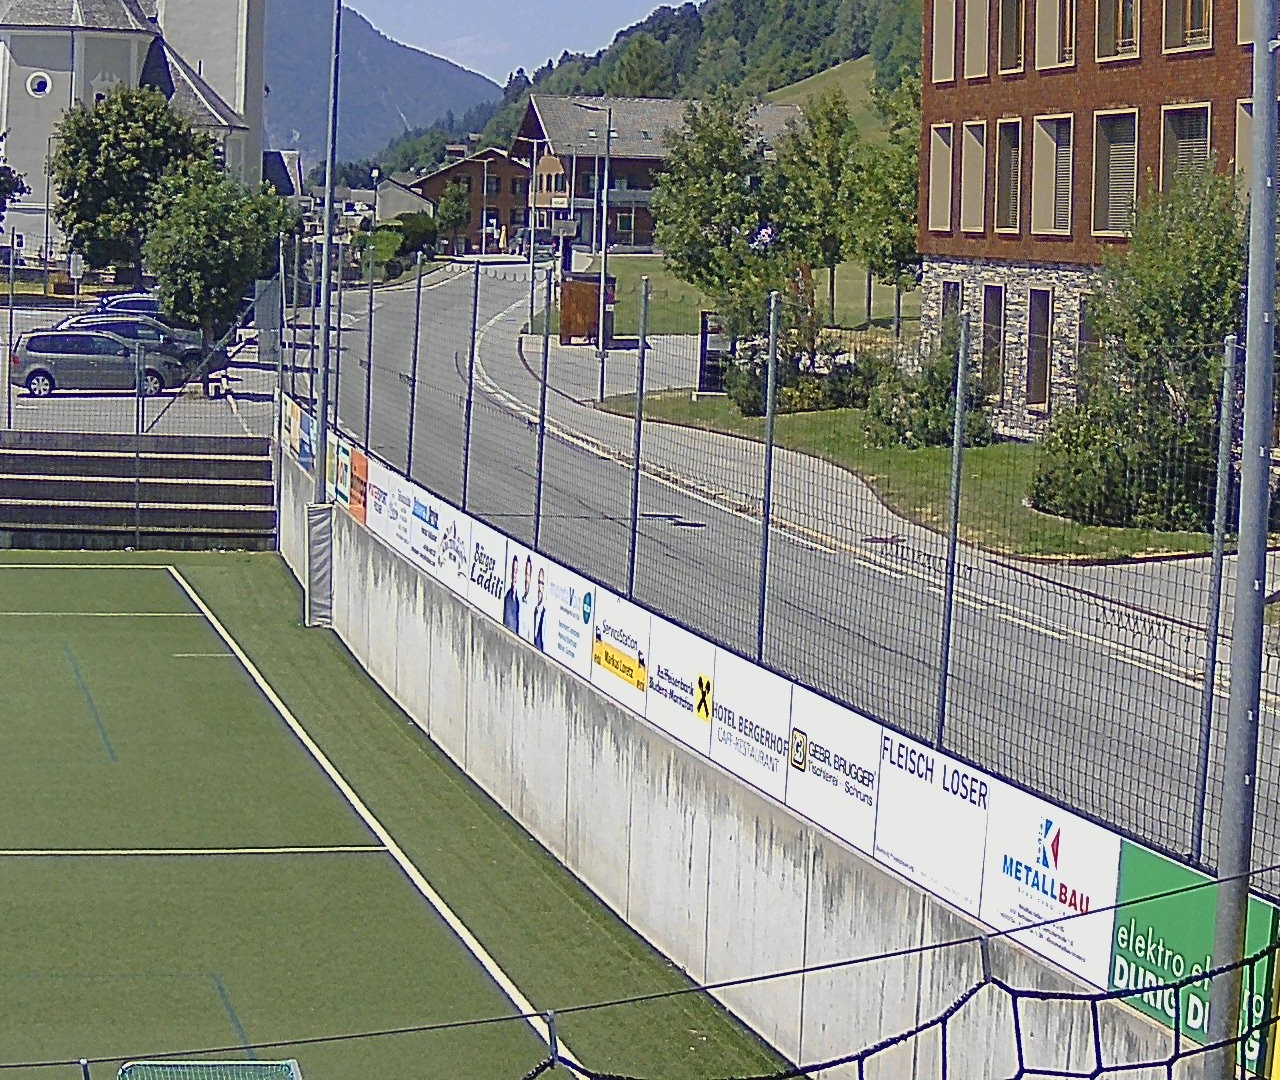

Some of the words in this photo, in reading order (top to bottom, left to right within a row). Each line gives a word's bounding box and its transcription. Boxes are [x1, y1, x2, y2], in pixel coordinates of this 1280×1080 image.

[712, 701, 736, 730] HOTEL
[738, 715, 789, 757] BERGERHOF
[844, 780, 873, 807] Schruns
[882, 735, 934, 784] FLEISCH
[942, 764, 988, 810] LOSER
[1002, 854, 1090, 915] METALLBAU
[1117, 917, 1184, 978] elektro
